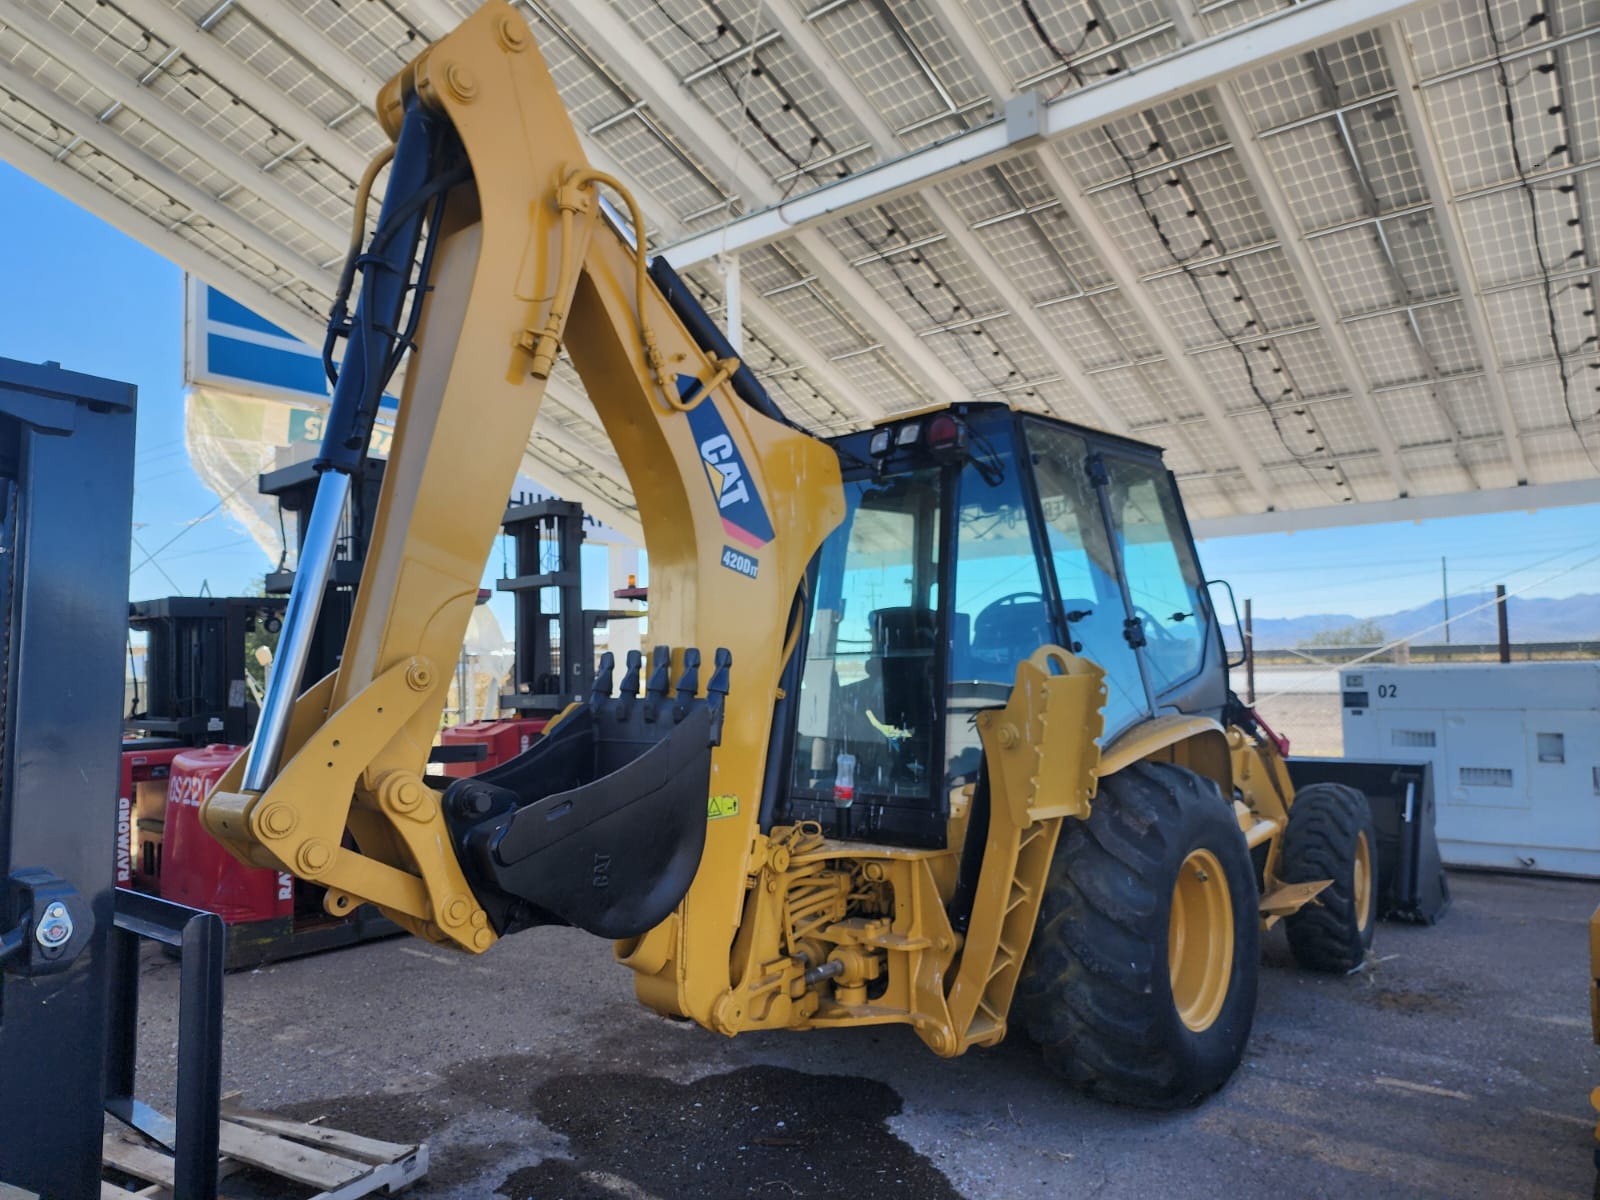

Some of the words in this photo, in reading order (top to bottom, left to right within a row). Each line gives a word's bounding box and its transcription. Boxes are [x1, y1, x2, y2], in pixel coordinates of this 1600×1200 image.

[701, 433, 750, 509] CAT
[1377, 684, 1398, 699] 02
[117, 797, 130, 882] RAYMOND
